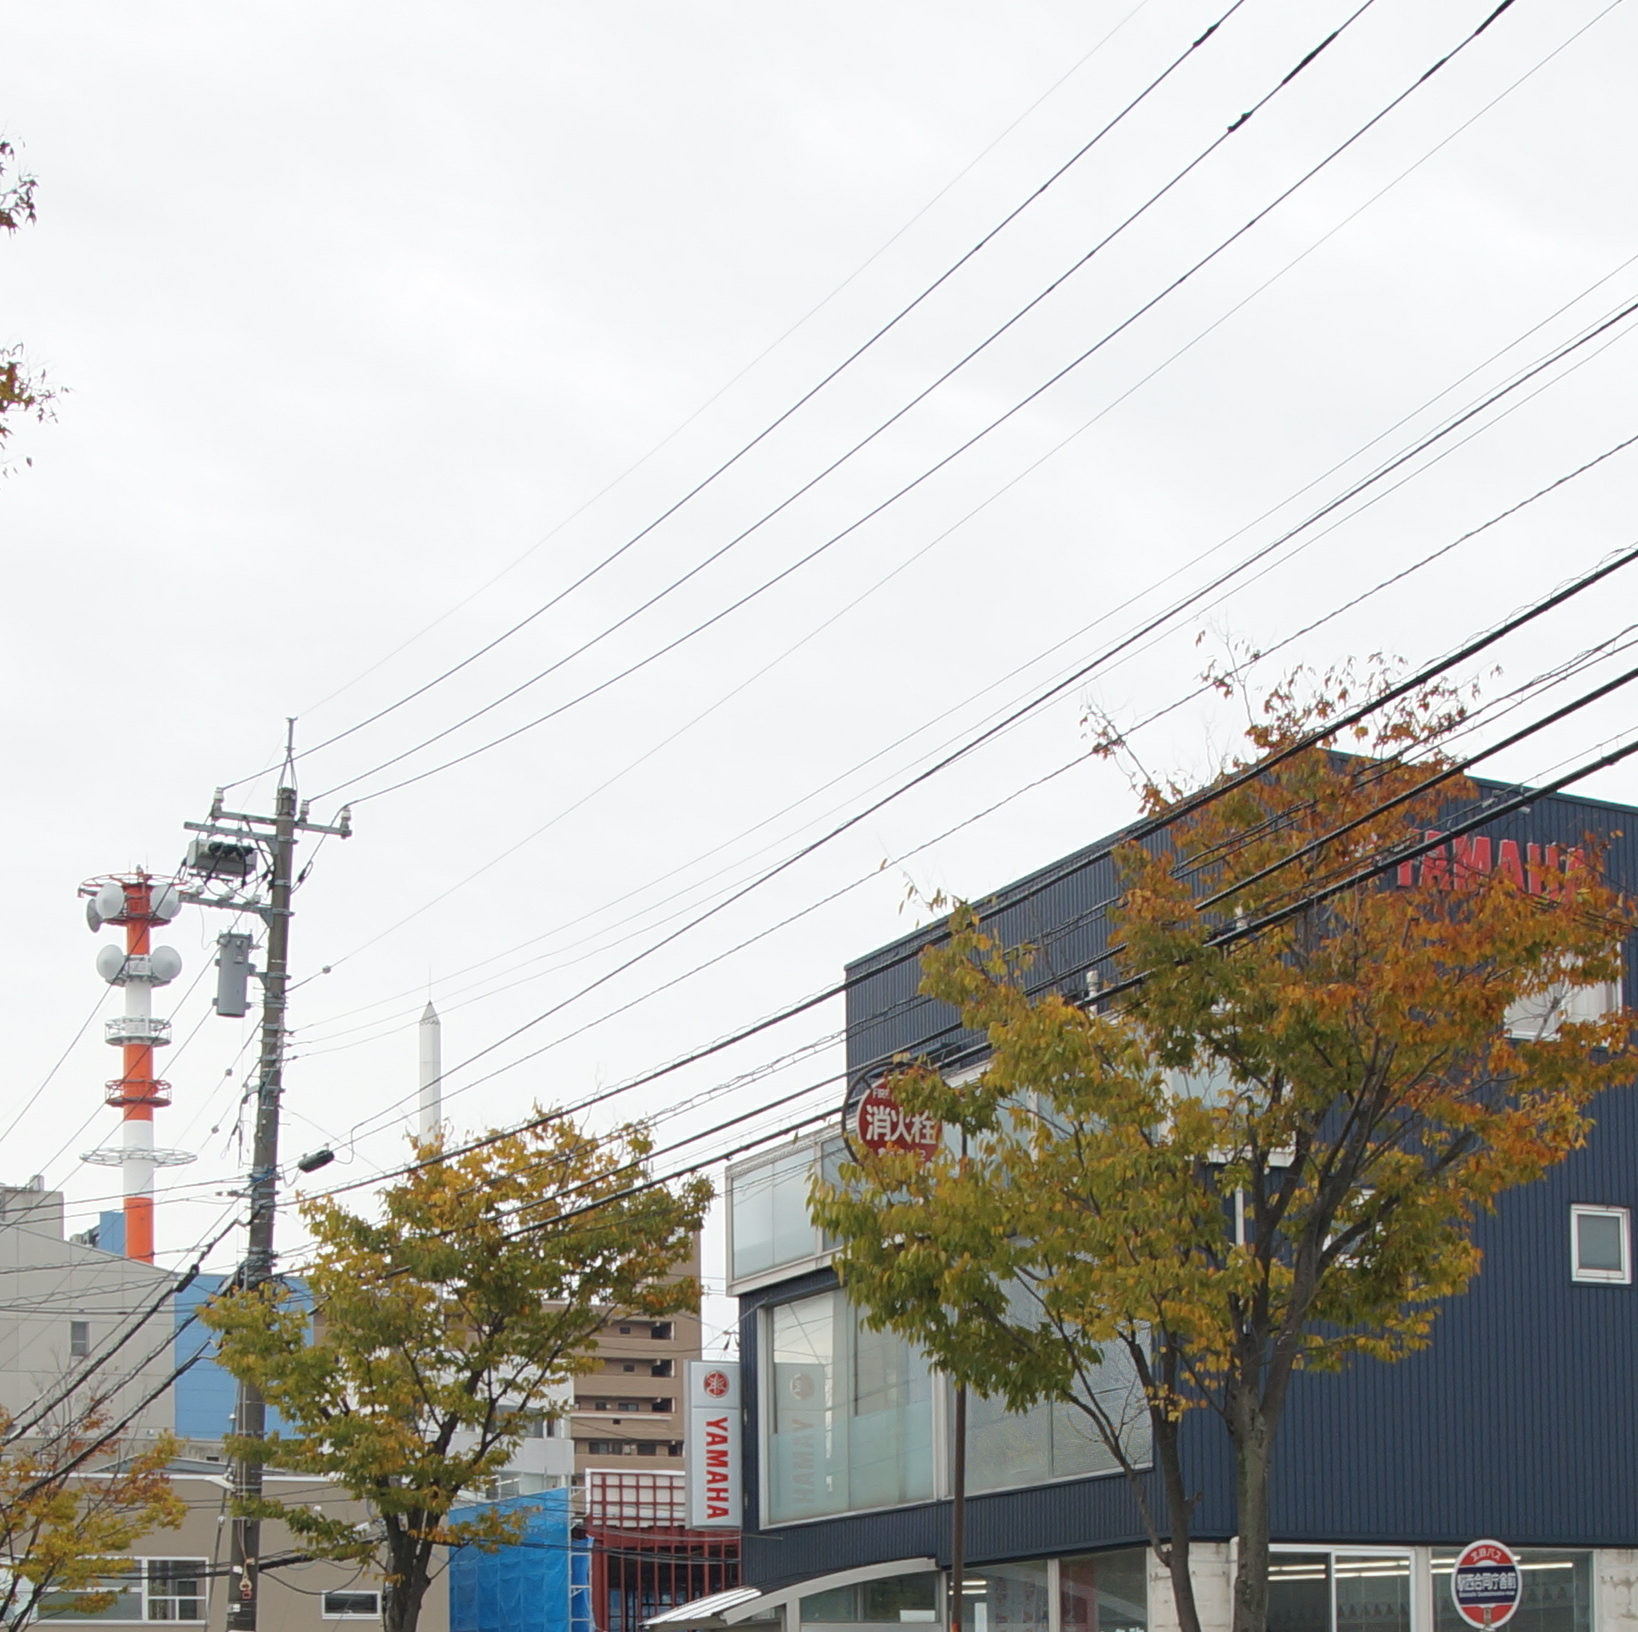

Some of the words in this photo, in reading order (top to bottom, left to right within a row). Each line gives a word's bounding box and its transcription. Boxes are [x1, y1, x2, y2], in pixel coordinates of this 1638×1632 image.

[865, 1104, 937, 1145] 消火栓
[705, 1416, 730, 1520] YAMAHA
